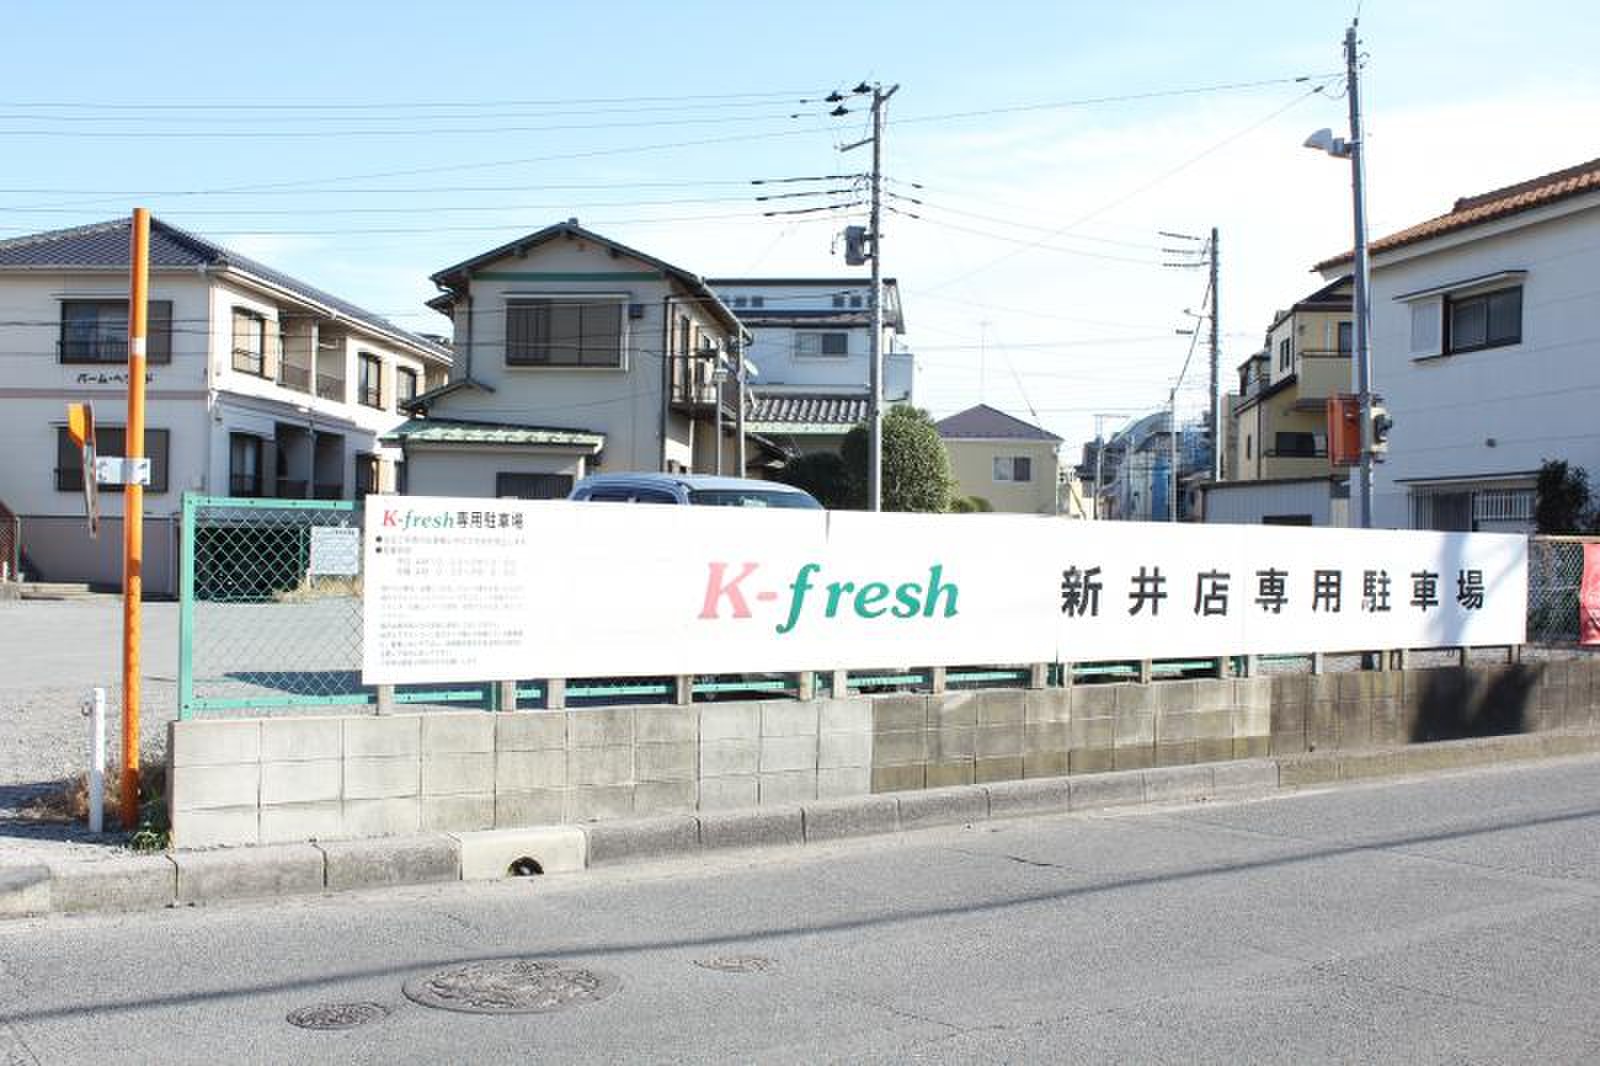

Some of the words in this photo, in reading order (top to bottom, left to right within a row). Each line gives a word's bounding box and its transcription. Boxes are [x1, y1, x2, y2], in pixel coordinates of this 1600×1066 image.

[697, 562, 960, 635] K-fresh
[1061, 566, 1486, 617] 新井店専用駐車場
